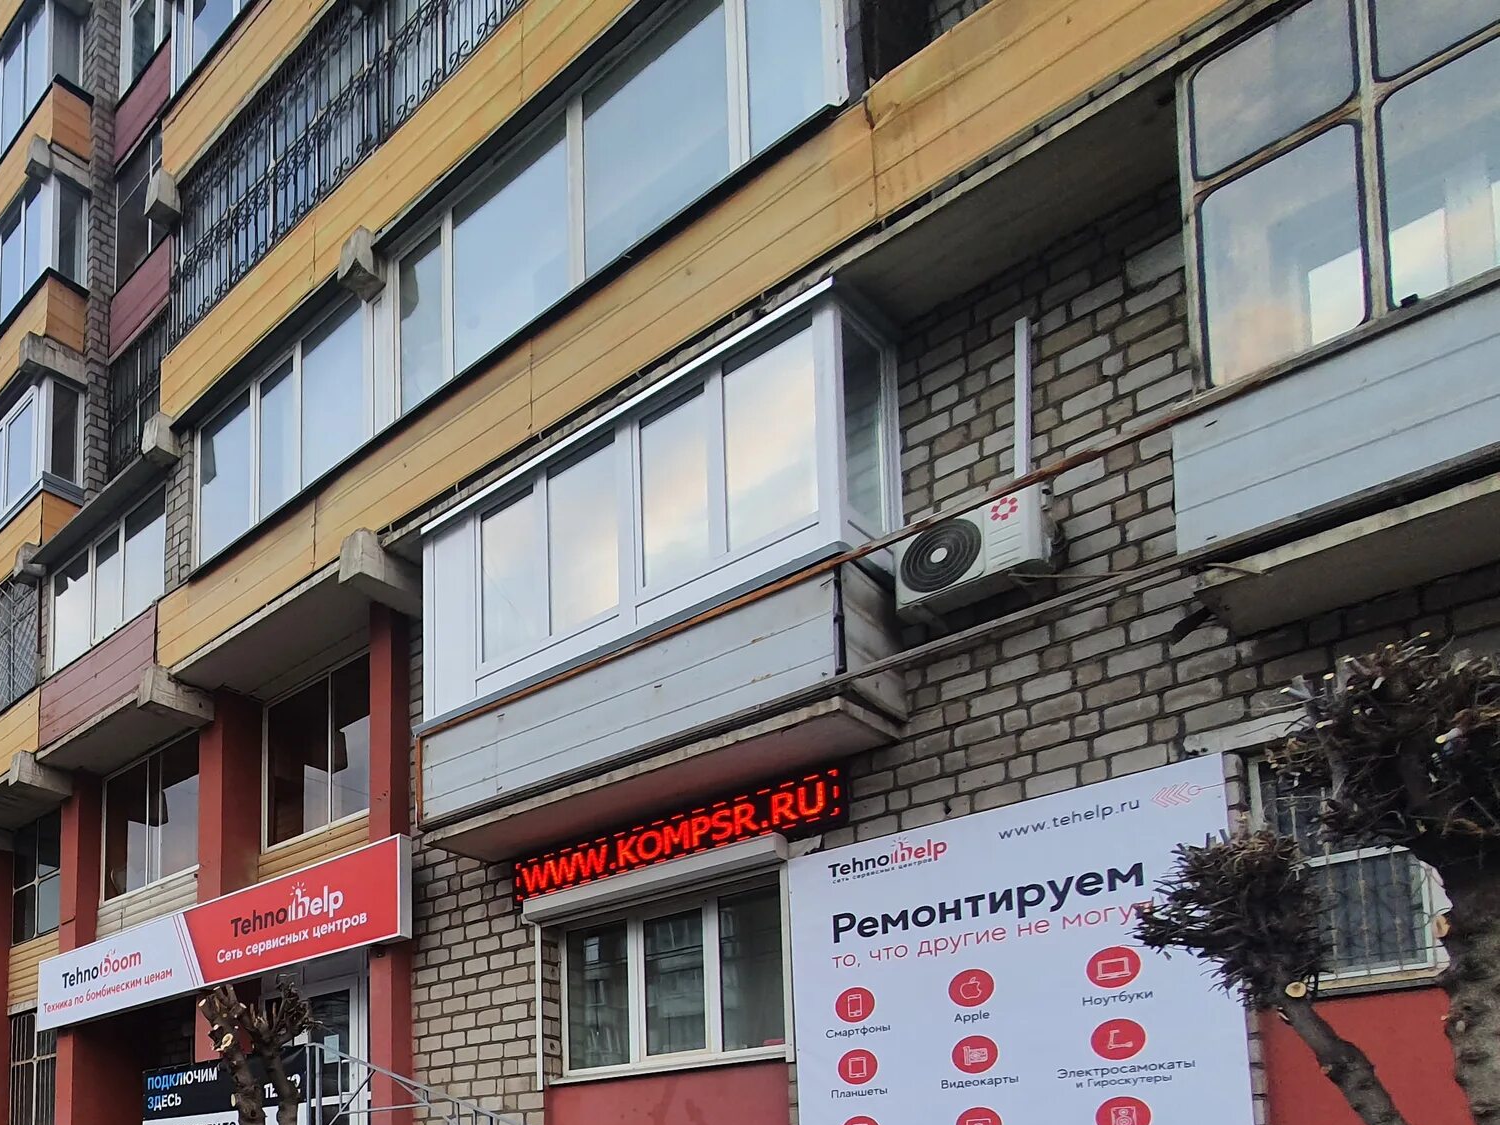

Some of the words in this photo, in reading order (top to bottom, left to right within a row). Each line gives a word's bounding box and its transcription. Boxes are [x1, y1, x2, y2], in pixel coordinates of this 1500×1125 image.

[998, 799, 1140, 840] www.tehelp.ru
[522, 781, 826, 893] WWW.KOMPSR.RU
[832, 862, 1145, 944] Ремонтируем
[217, 947, 243, 963] Сеть
[245, 928, 308, 957] сервисных
[312, 912, 368, 938] центров
[832, 953, 861, 969] то,
[869, 944, 908, 962] что
[917, 927, 1007, 957] другие
[1017, 918, 1050, 938] не
[1062, 901, 1153, 930] могу
[44, 999, 73, 1014] Техника
[75, 995, 84, 1005] по
[86, 978, 142, 1002] бомбическим
[144, 968, 173, 986] ценам
[1082, 991, 1153, 1007] Ноутбуки
[954, 1010, 990, 1024] Apple
[826, 1024, 891, 1039] Смартфоны
[147, 1067, 218, 1091] ПОДКЛЮЧИМ
[1057, 1060, 1196, 1079] Электросамокаты
[941, 1075, 1019, 1089] Видеокарты
[1087, 1074, 1172, 1088] Гироскутеры
[147, 1093, 182, 1111] ЗДЕСЬ
[831, 1087, 888, 1099] Планшеты
